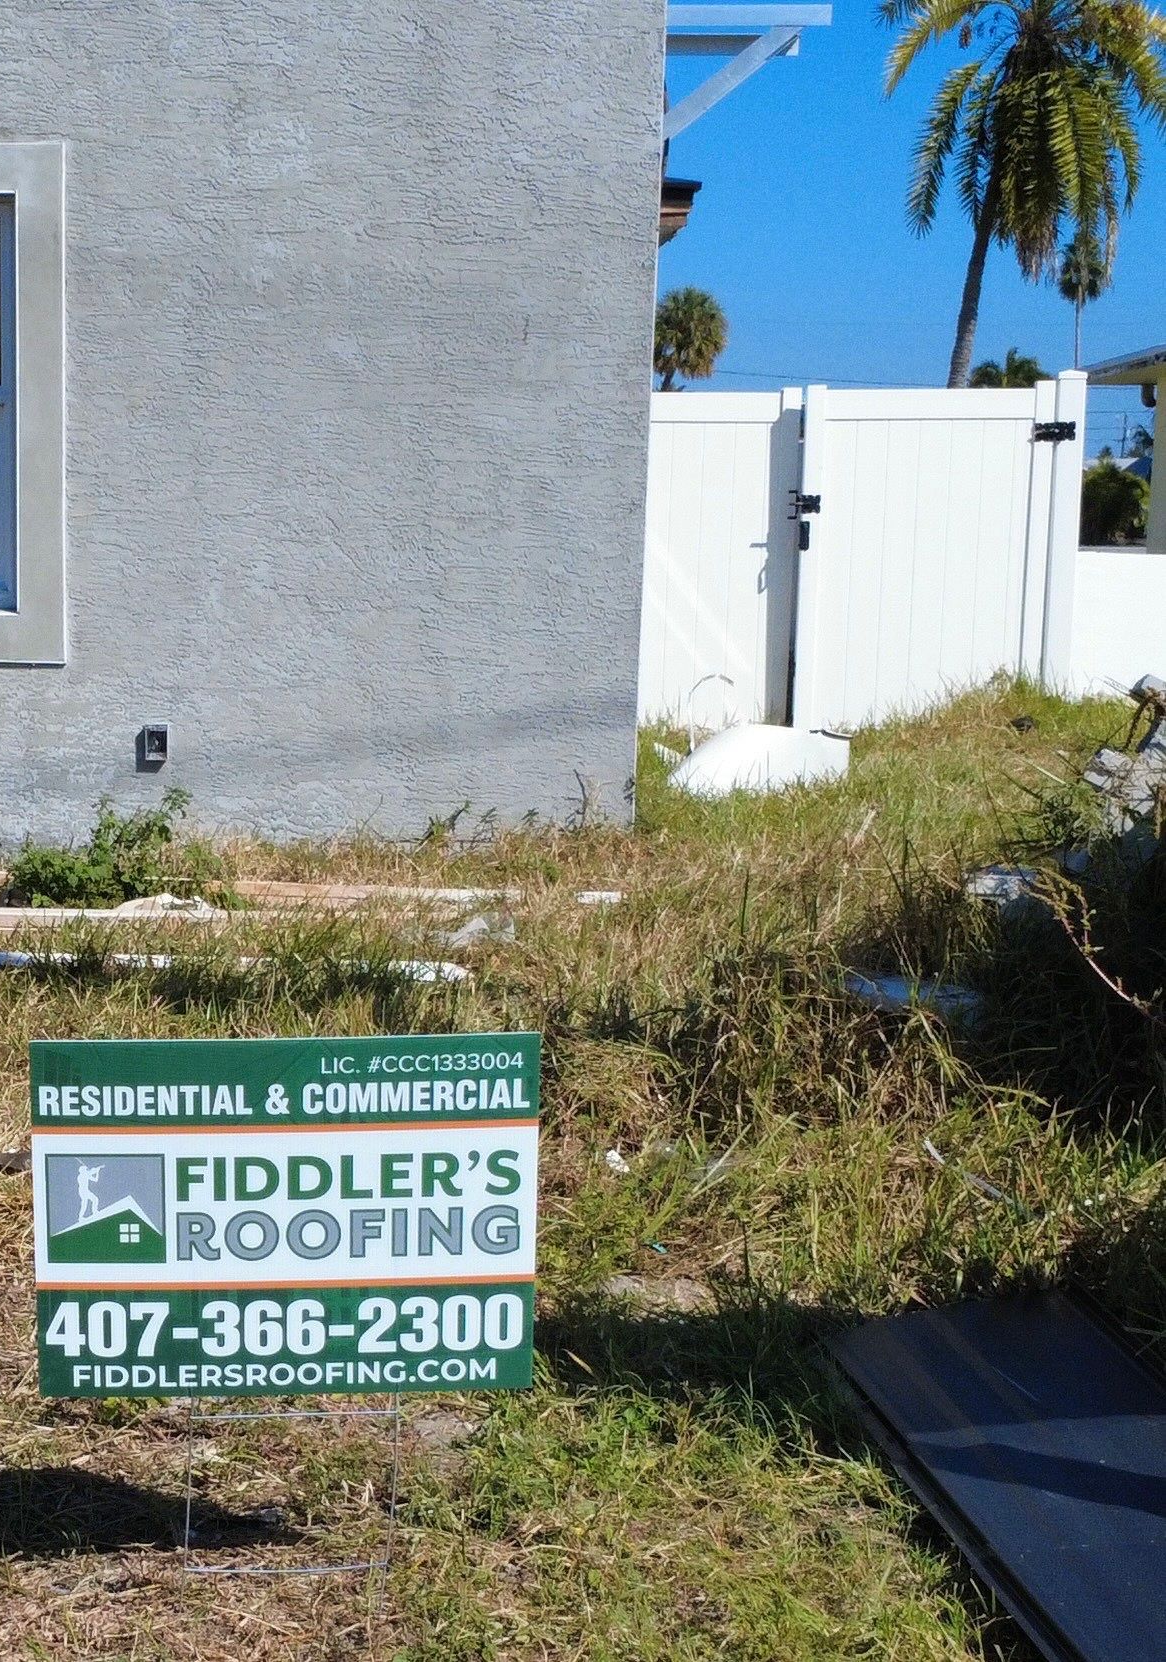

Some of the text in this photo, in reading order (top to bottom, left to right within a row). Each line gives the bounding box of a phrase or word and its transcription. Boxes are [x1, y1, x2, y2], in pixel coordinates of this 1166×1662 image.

[320, 1052, 524, 1075] LIC. #CCC1333004
[38, 1078, 530, 1117] RESIDENTIAL & COMMERCIAL
[175, 1149, 522, 1202] FIDDLER'S
[176, 1204, 521, 1261] ROOFING
[45, 1293, 524, 1357] 407-366-2300
[72, 1357, 497, 1388] FIDDLERSROOFING.COM
